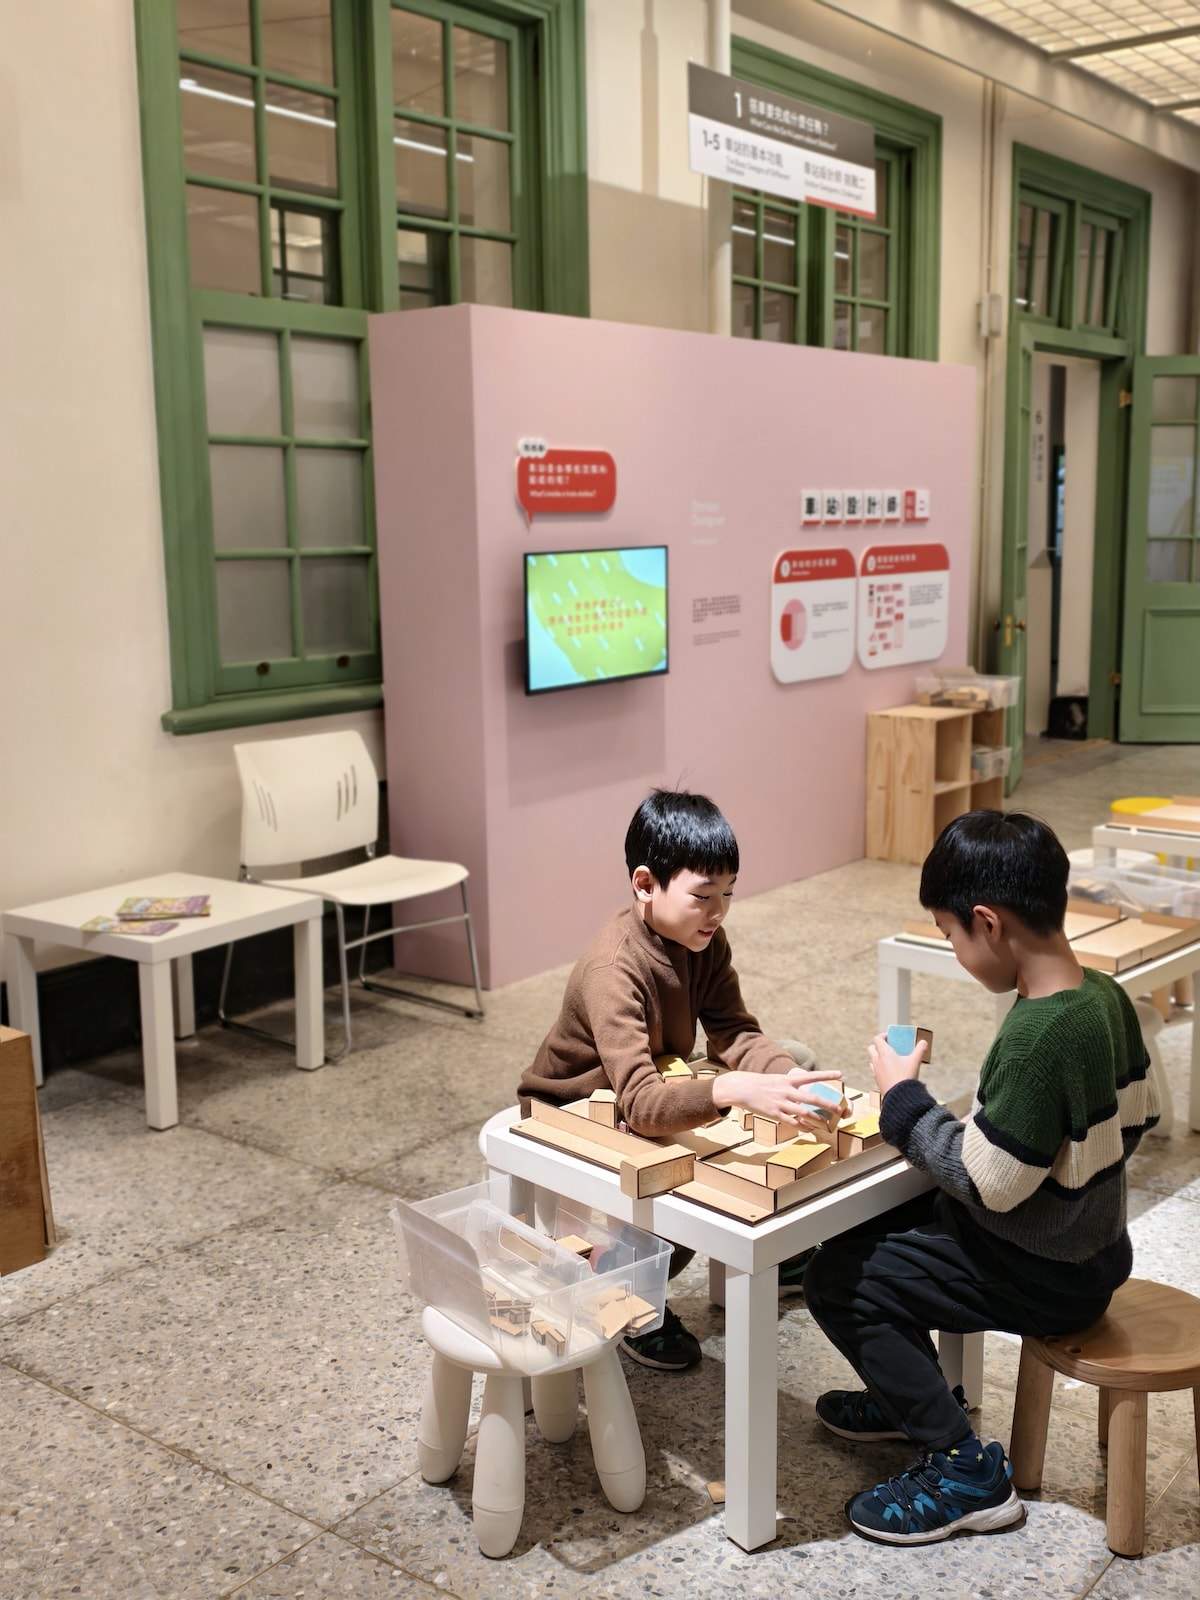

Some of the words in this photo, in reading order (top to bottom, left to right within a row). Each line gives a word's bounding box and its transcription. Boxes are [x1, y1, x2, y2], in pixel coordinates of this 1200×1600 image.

[734, 92, 742, 118] 1
[702, 129, 720, 150] 1-5
[804, 161, 842, 183] 車站設計師
[805, 496, 897, 516] 車站設計師
